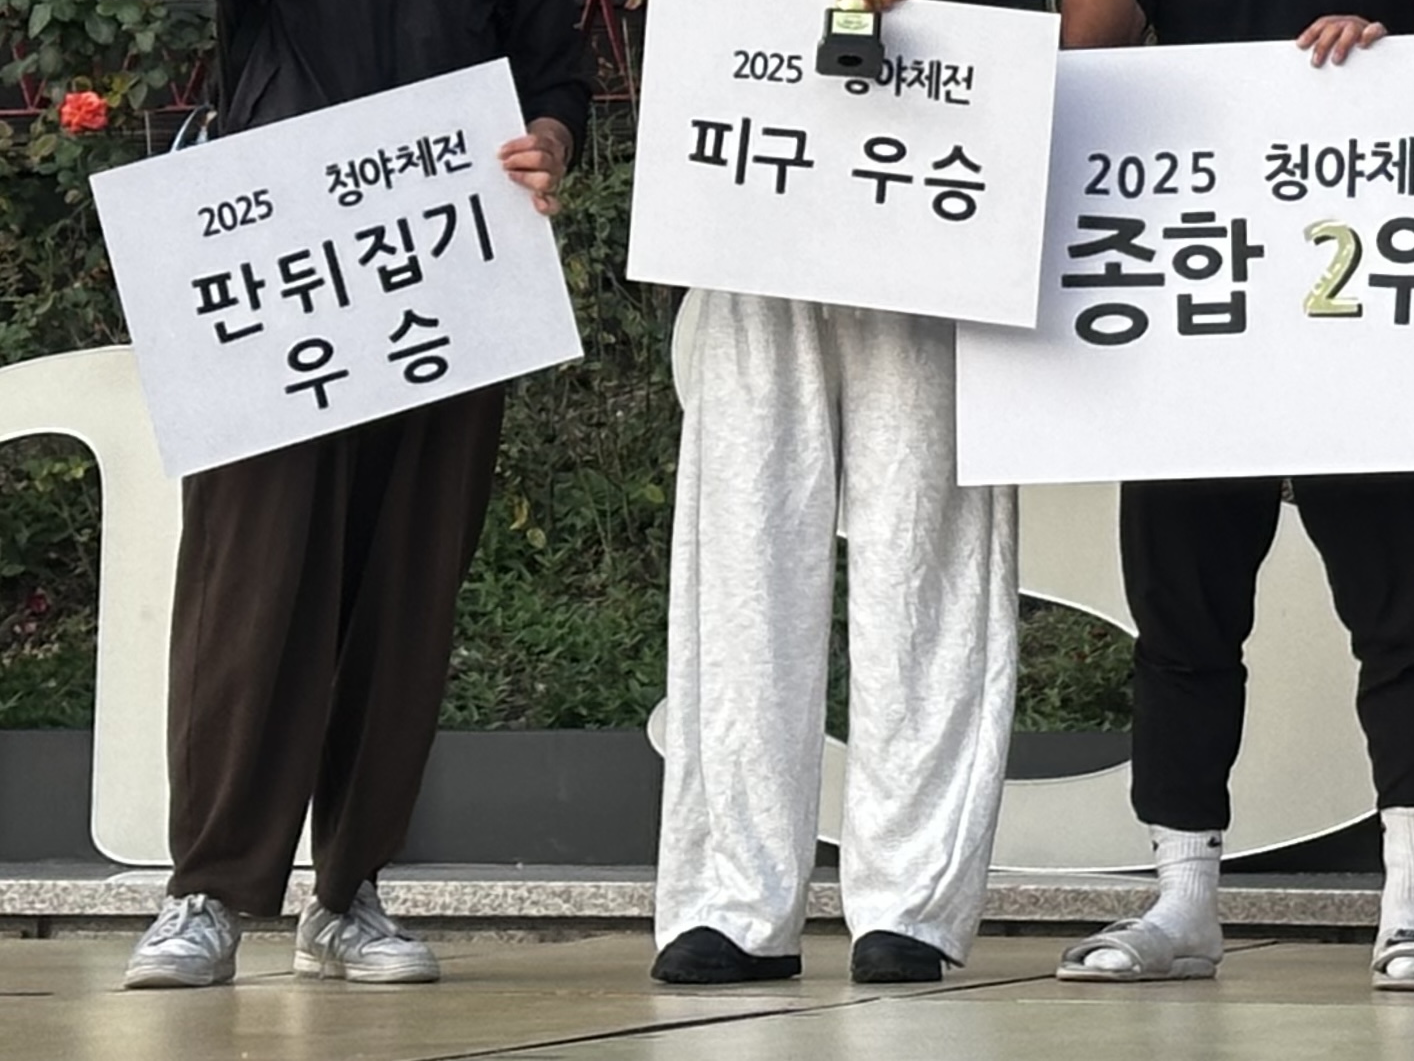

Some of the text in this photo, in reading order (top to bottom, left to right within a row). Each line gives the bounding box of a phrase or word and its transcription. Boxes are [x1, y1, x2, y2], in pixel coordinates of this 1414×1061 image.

[732, 49, 804, 85] 2025
[197, 129, 473, 237] 2025 청야체전
[689, 116, 986, 222] 피구 우승
[1083, 151, 1216, 199] 2025
[191, 193, 495, 344] 판뒤집기
[1061, 210, 1265, 346] 종합
